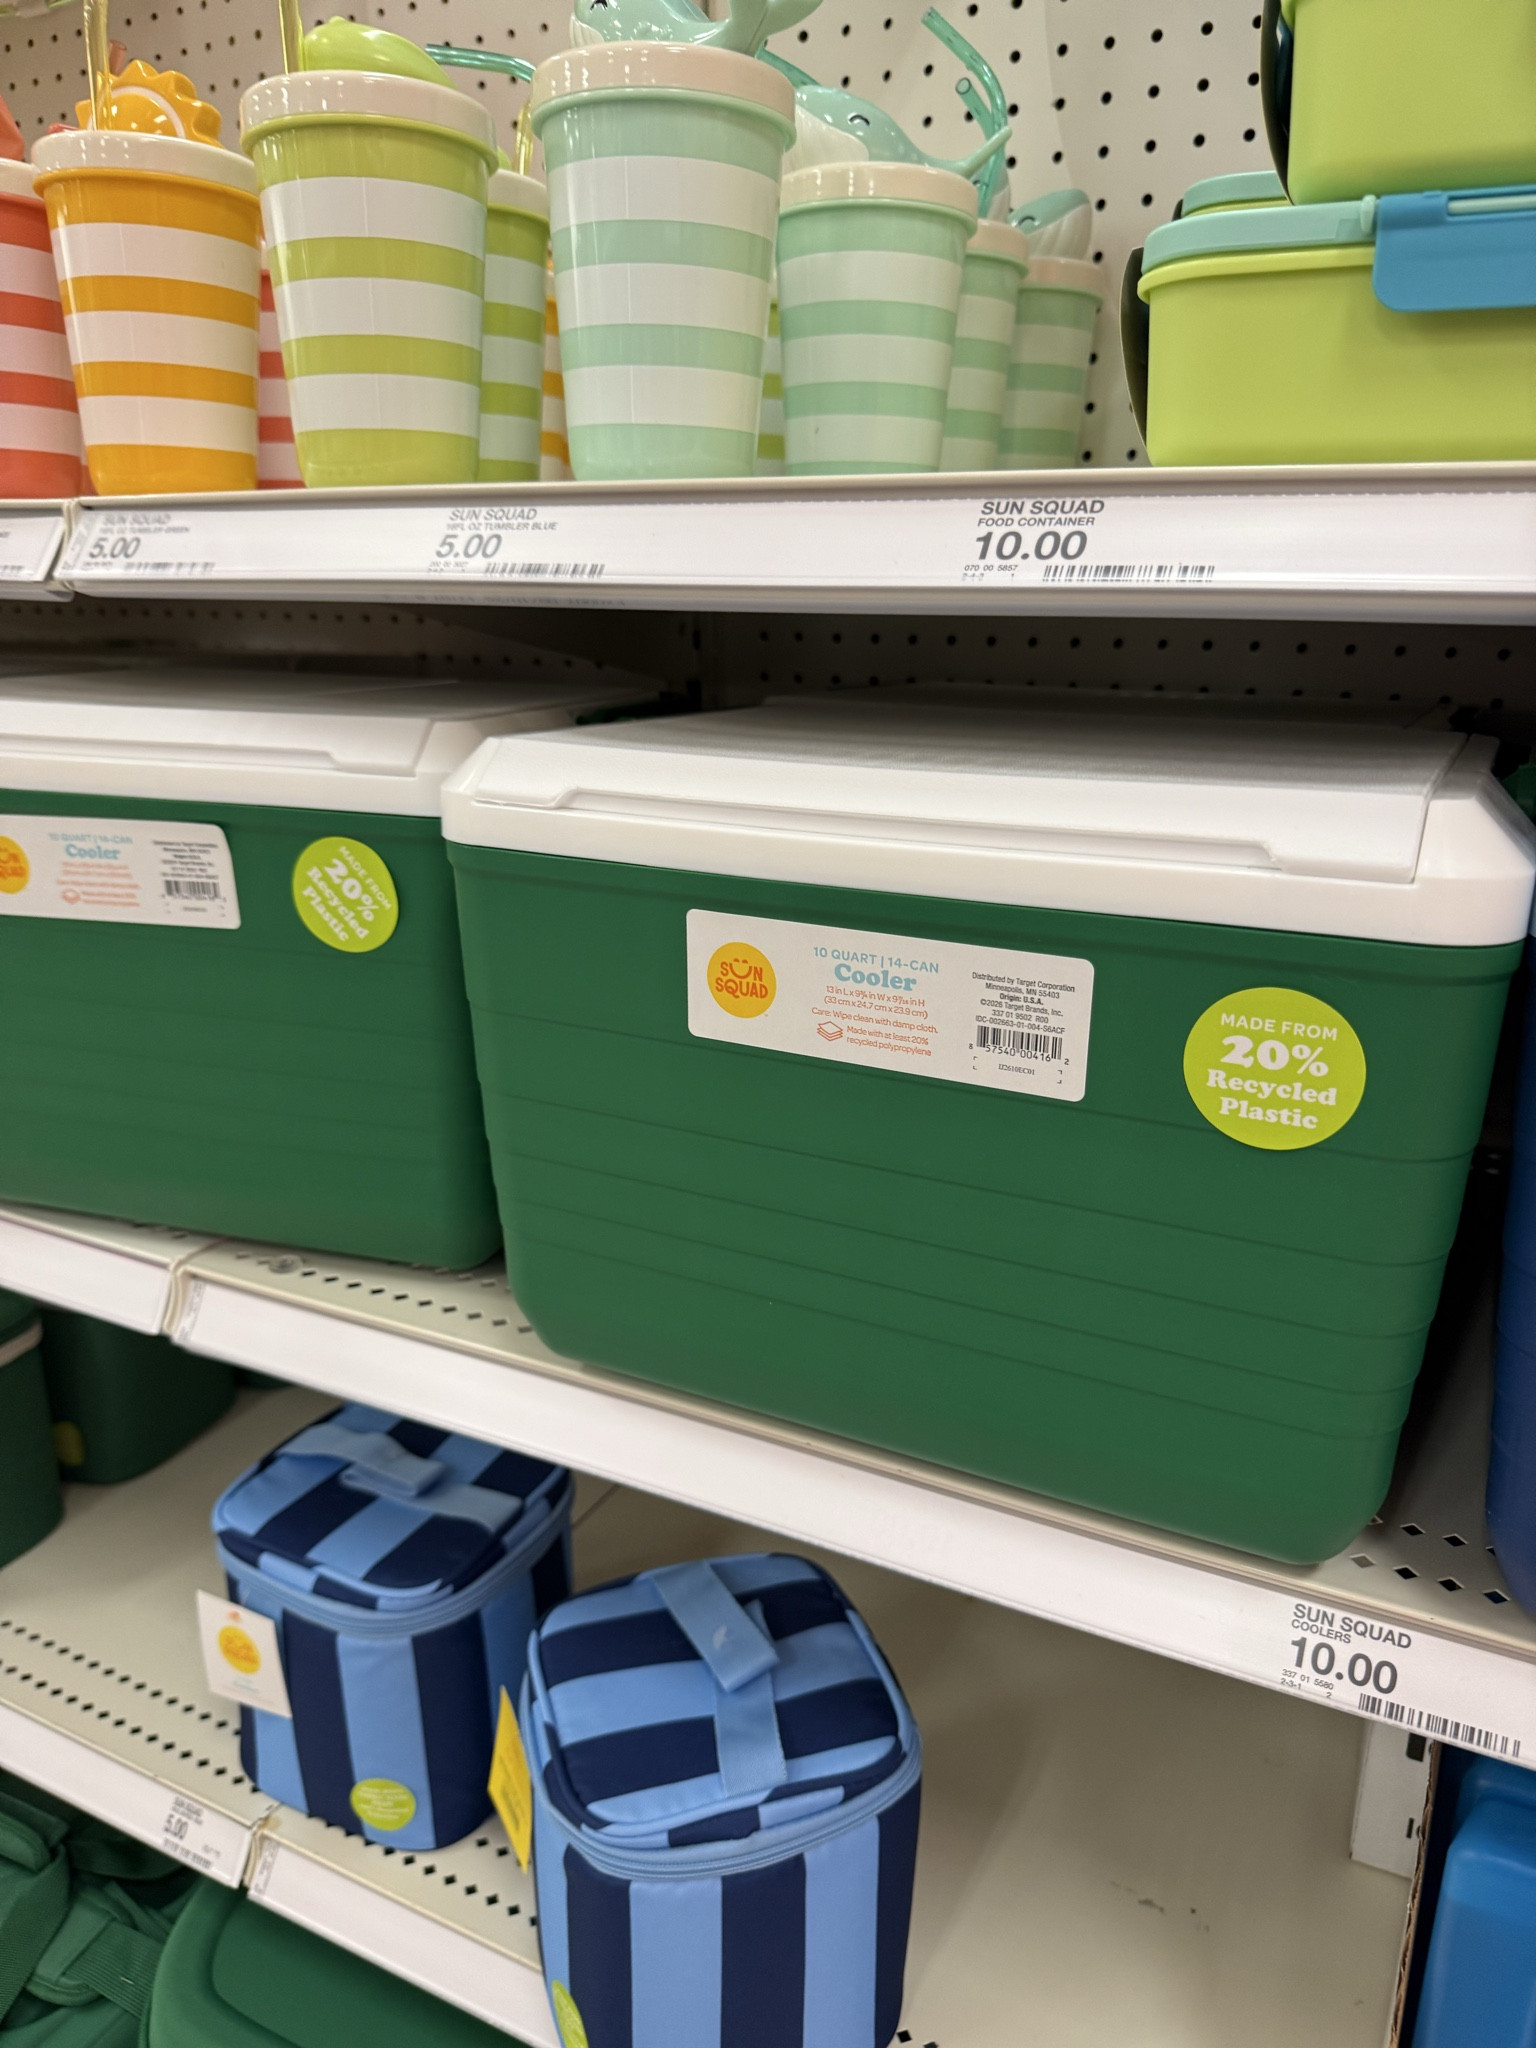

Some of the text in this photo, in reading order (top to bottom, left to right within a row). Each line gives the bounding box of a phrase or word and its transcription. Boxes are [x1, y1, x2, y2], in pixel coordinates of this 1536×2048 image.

[450, 508, 537, 521] SUN SQUAD
[981, 500, 1104, 515] SUN SQUAD
[484, 522, 528, 531] TUMBLER
[531, 522, 558, 531] BLUE
[978, 517, 1096, 527] FOOD CONTAINER
[89, 537, 141, 559] 5.00
[436, 534, 502, 558] 5.00
[976, 531, 1088, 560] 10.00
[64, 844, 121, 860] Cooler
[324, 858, 379, 922] 20%
[366, 878, 392, 910] FROM
[302, 886, 349, 941] Plastic
[306, 866, 370, 939] Recycled
[720, 960, 763, 982] SUN
[814, 947, 827, 958] 10
[831, 950, 877, 965] QUART
[888, 957, 939, 973] 14-CAN
[715, 976, 768, 999] SQUAD
[834, 964, 917, 991] Cooler
[972, 972, 1075, 993] Distributed by Target Corporation
[985, 982, 1024, 995] Minneapolis,
[1026, 988, 1037, 996] MN
[824, 995, 836, 1005] (33
[857, 1000, 873, 1009] 24.7
[874, 1004, 887, 1012] cm
[894, 1006, 911, 1015] 23.9
[912, 1010, 929, 1020] cm)
[826, 985, 834, 993] 13
[835, 986, 842, 994] in
[868, 991, 876, 999] in
[877, 993, 886, 1001] W
[909, 997, 917, 1006] in
[918, 999, 925, 1007] H
[999, 993, 1044, 1005] Origin: U.S.A.
[811, 1007, 938, 1034] Care: Wipe clean with damp cloth.
[1004, 1002, 1024, 1012] Target
[1025, 1004, 1049, 1016] Brands,
[1051, 1008, 1064, 1017] Inc.
[847, 1025, 867, 1036] Made
[868, 1029, 884, 1038] with
[892, 1033, 911, 1043] least
[911, 1036, 929, 1045] 20%
[1220, 1012, 1338, 1041] MADE FROM
[846, 1036, 932, 1056] recycled polypropylene
[985, 1044, 1016, 1057] 57540
[1020, 1049, 1051, 1062] 00416
[1219, 1035, 1329, 1077] 20%
[1206, 1068, 1337, 1106] Recycled
[1219, 1096, 1319, 1129] Plastic
[1291, 1619, 1351, 1644] COOLERS
[1292, 1603, 1412, 1649] SUN SQUAD
[1281, 1668, 1297, 1679] 337
[1300, 1674, 1310, 1683] 01
[1290, 1636, 1398, 1695] 10.00
[1280, 1677, 1302, 1690] 2-3-1
